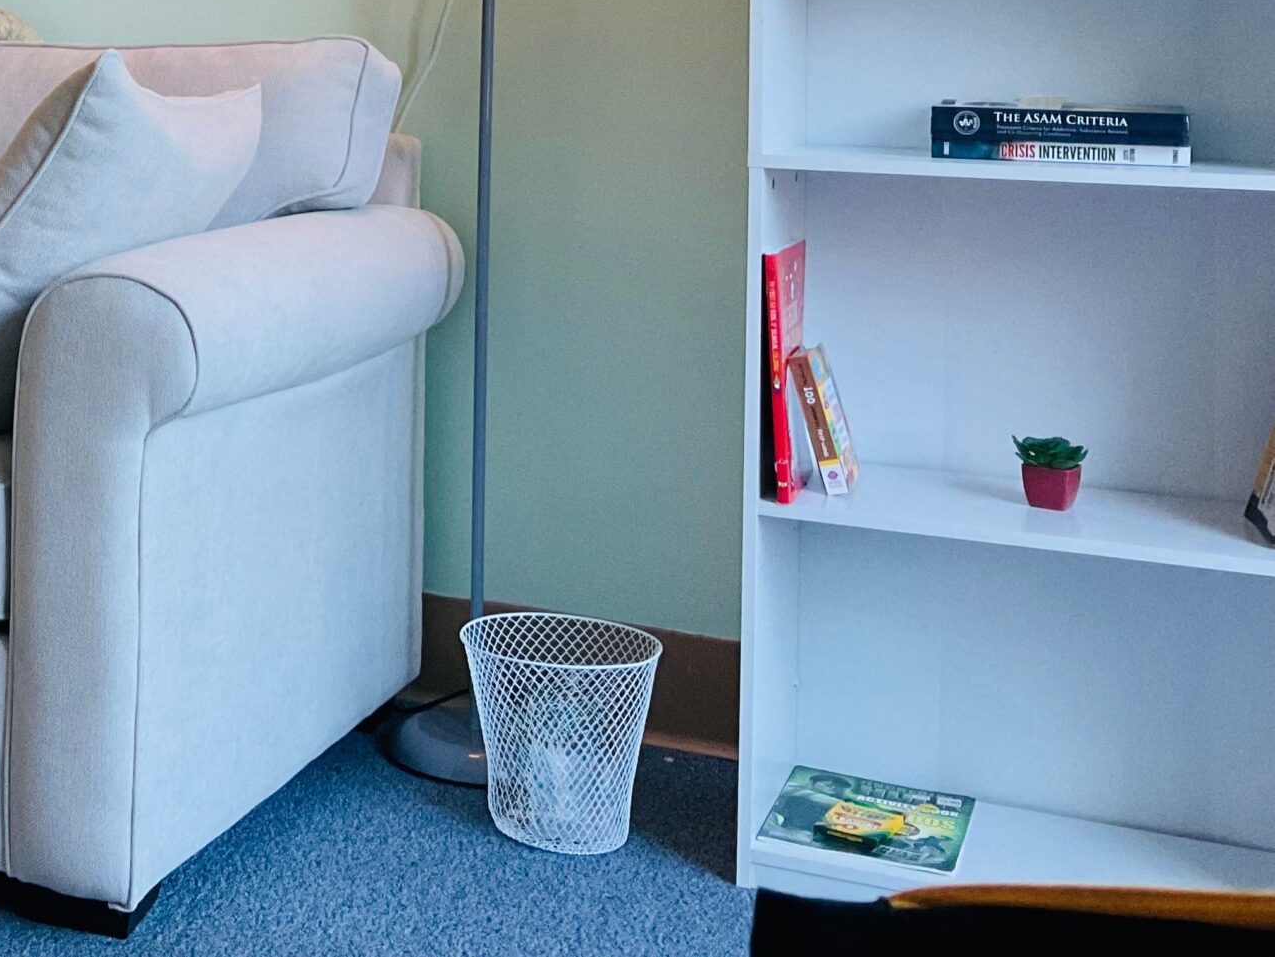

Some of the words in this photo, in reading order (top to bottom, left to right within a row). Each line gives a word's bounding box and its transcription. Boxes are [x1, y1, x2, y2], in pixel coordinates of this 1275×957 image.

[993, 111, 1021, 123] THE
[1024, 112, 1062, 125] ASAM
[1065, 114, 1129, 127] CRITERIA
[1001, 143, 1036, 159] CRISIS
[1038, 145, 1116, 162] INTERVENTION
[803, 386, 816, 405] 100
